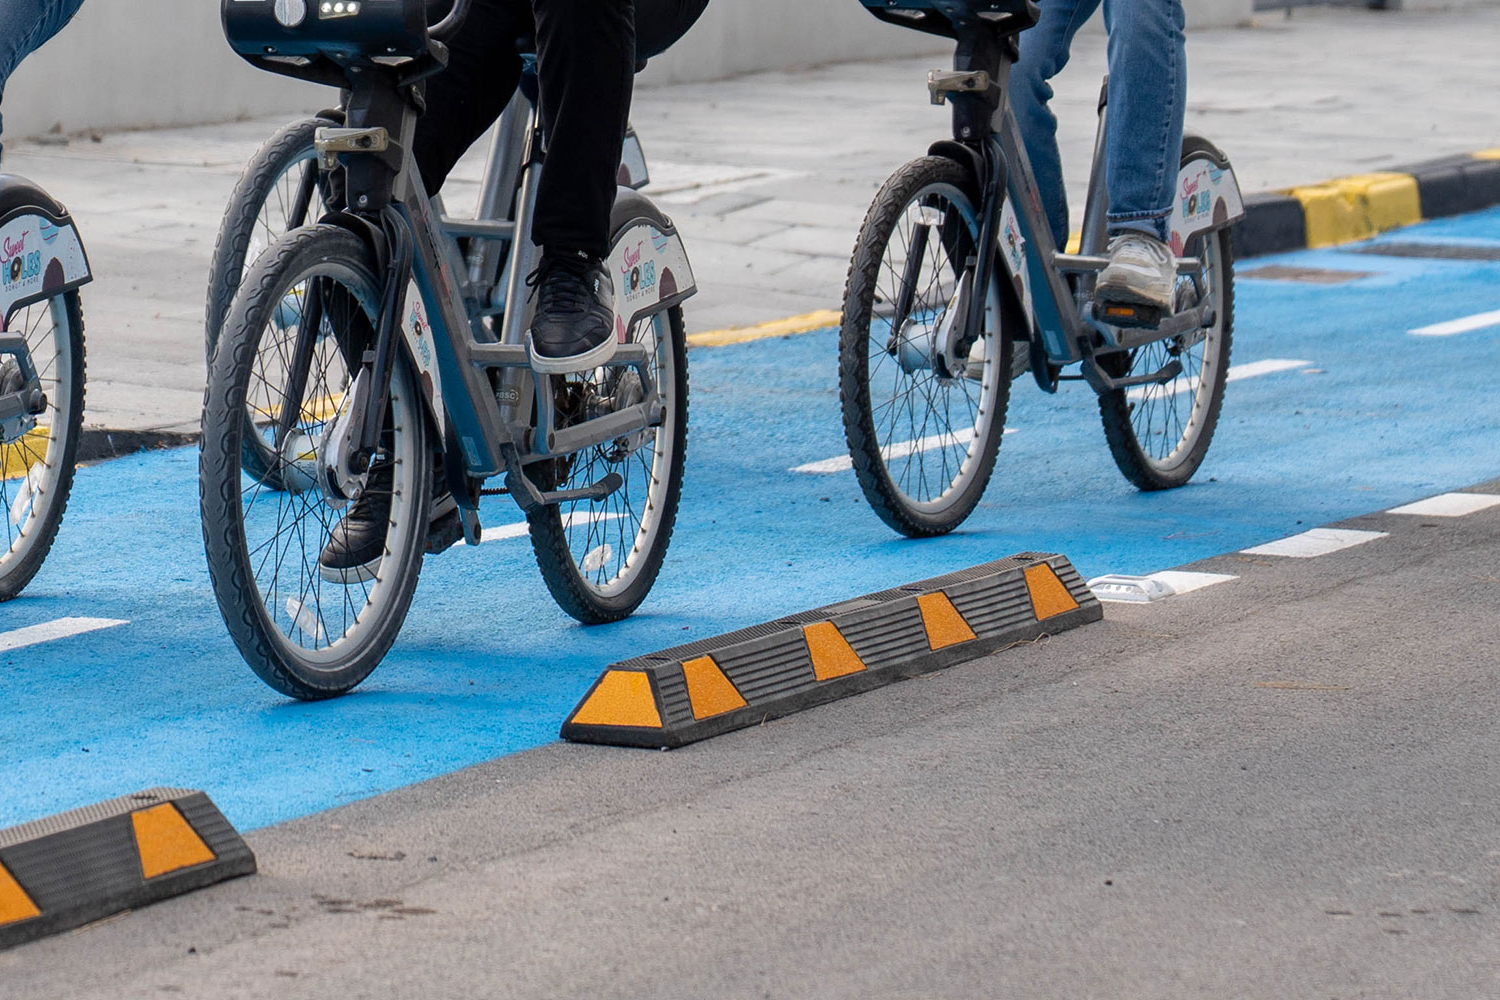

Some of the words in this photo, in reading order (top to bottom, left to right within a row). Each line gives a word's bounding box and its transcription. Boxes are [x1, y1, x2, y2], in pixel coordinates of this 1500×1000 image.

[0, 230, 29, 264] Sweet
[620, 240, 643, 274] Sweet
[2, 250, 41, 286] HOLES
[623, 259, 656, 296] HOLES
